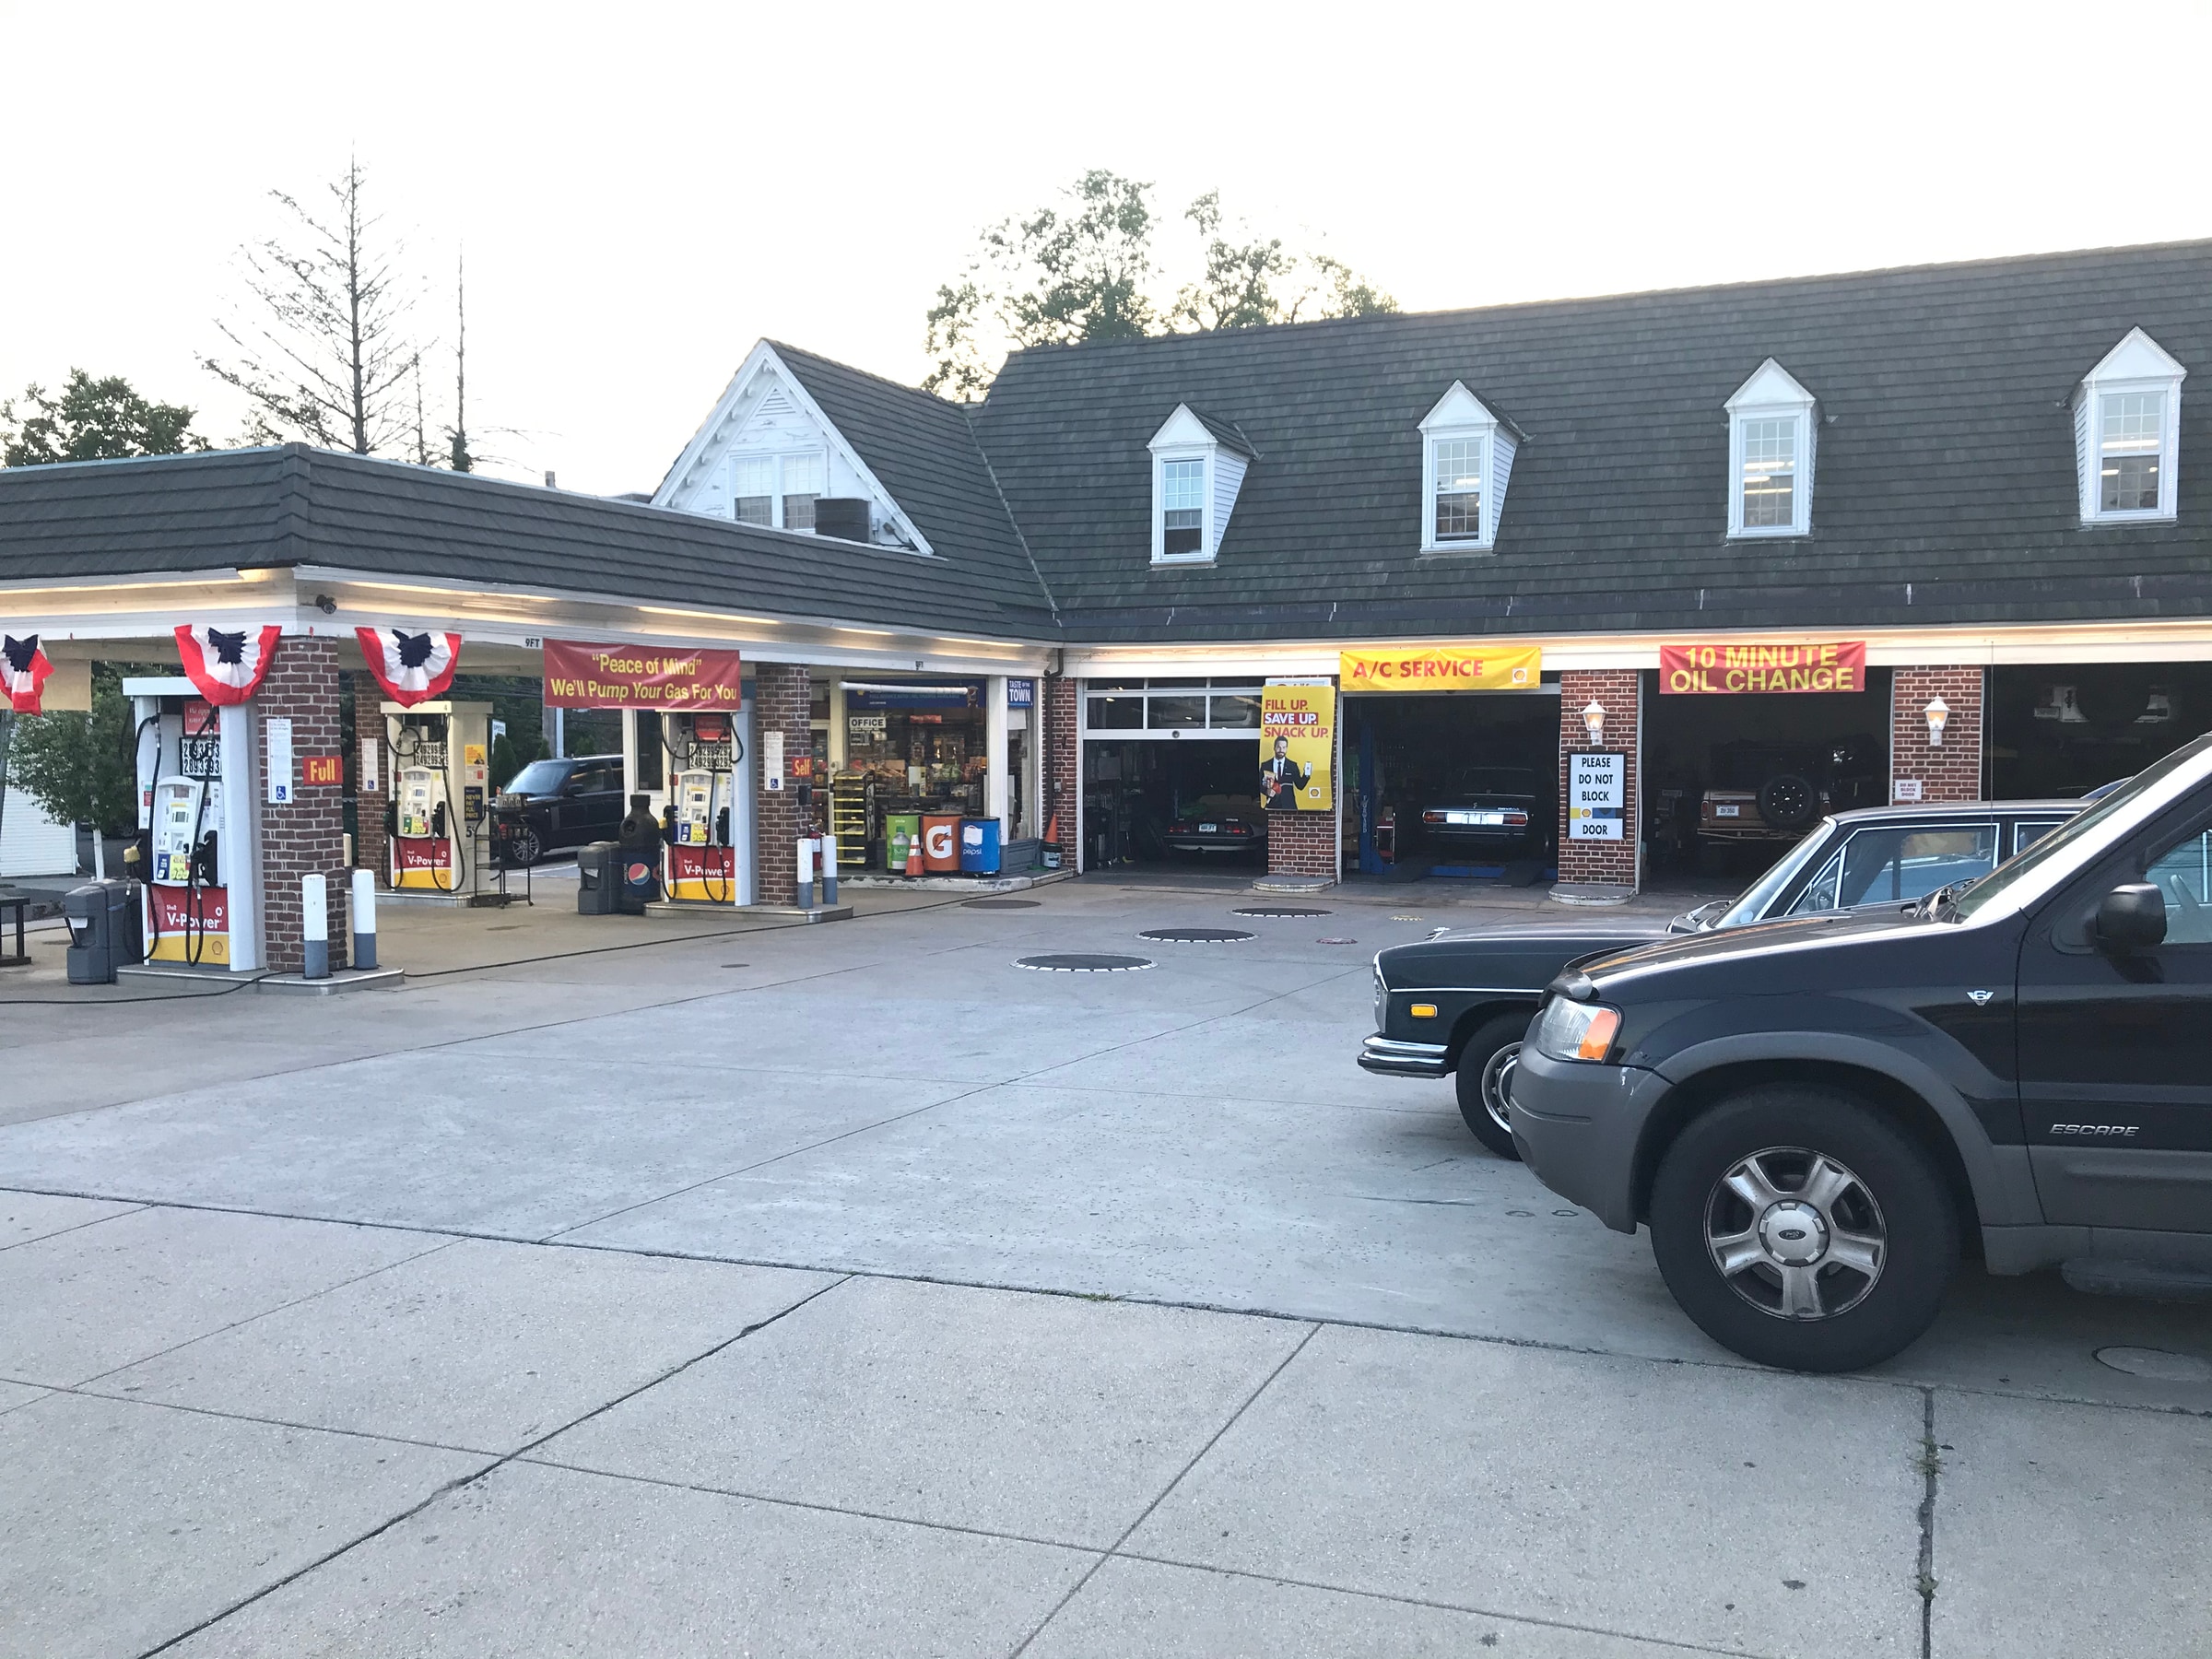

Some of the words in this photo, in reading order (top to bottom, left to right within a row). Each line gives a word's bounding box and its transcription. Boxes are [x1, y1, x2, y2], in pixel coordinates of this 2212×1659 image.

[525, 638, 540, 648] 9FT
[1686, 647, 1716, 668] 10
[1725, 644, 1838, 668] MINUTE
[646, 657, 659, 674] of
[1352, 661, 1392, 679] A/C
[1400, 660, 1484, 677] SERVICE
[1009, 680, 1021, 688] TASTE
[1670, 670, 1718, 691] OIL
[1725, 667, 1854, 691] CHANGE
[551, 678, 584, 697] We'll
[588, 680, 629, 702] Pump
[632, 682, 662, 700] Your
[665, 683, 688, 700] Gas
[692, 684, 712, 700] For
[714, 684, 736, 700] You
[1009, 688, 1030, 701] TOWN
[1265, 700, 1287, 711] FILL
[1290, 700, 1308, 711] UP.
[852, 718, 884, 726] OFFICE
[1265, 713, 1294, 724] SAVE
[1299, 713, 1317, 724] UP.
[1264, 727, 1306, 737] SNACK
[1311, 727, 1328, 737] UP.
[794, 759, 810, 775] Self
[1582, 758, 1611, 767] PLEASE
[310, 759, 335, 782] Full
[1579, 774, 1592, 784] DO
[1595, 774, 1613, 784] NOT
[1582, 791, 1609, 801] BLOCK
[1583, 825, 1607, 835] DOOR
[407, 855, 443, 866] V-Power
[684, 865, 727, 877] V-Power
[2049, 1124, 2139, 1135] ESCAPE
